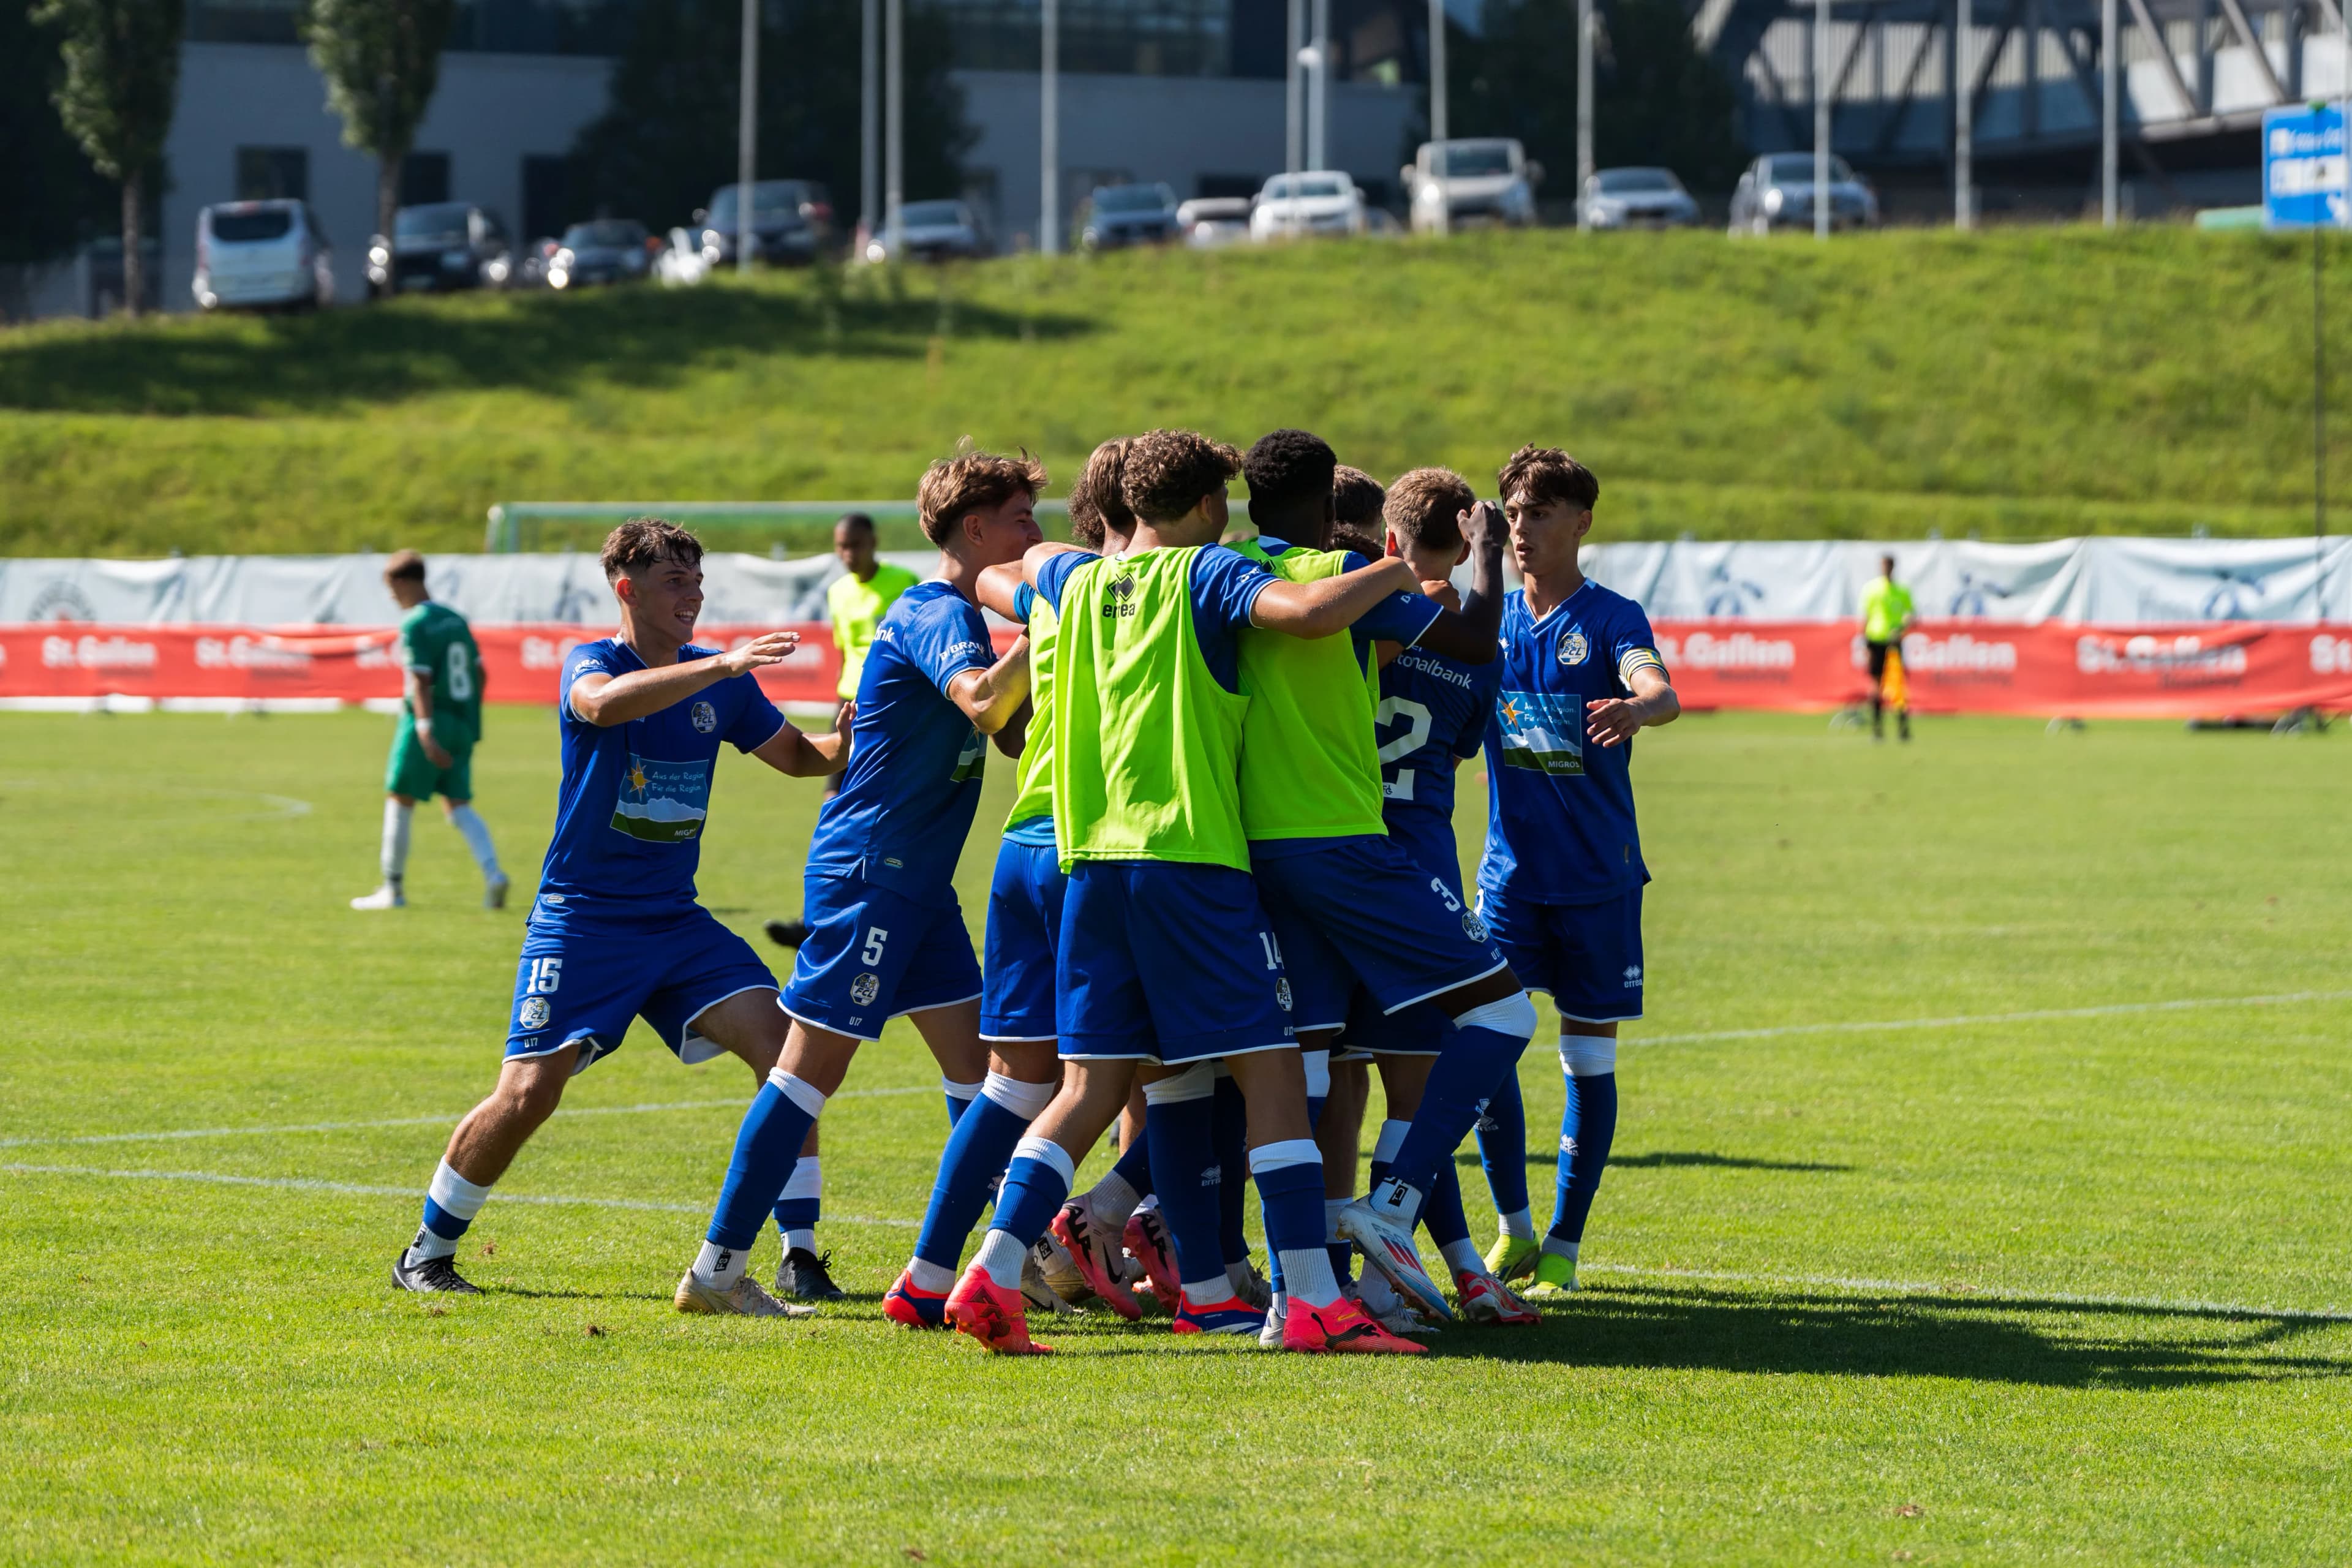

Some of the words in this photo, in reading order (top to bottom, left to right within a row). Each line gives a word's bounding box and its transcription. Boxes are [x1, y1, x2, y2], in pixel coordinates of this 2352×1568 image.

[1562, 647, 1582, 656] FCL
[447, 642, 472, 701] 8
[696, 716, 714, 725] FCL
[652, 771, 667, 780] Aus
[1431, 877, 1461, 911] 3
[861, 927, 888, 967] 5
[1259, 932, 1285, 970] 14
[527, 957, 563, 994] 15
[855, 987, 873, 998] FCL
[1279, 993, 1291, 1002] FCL
